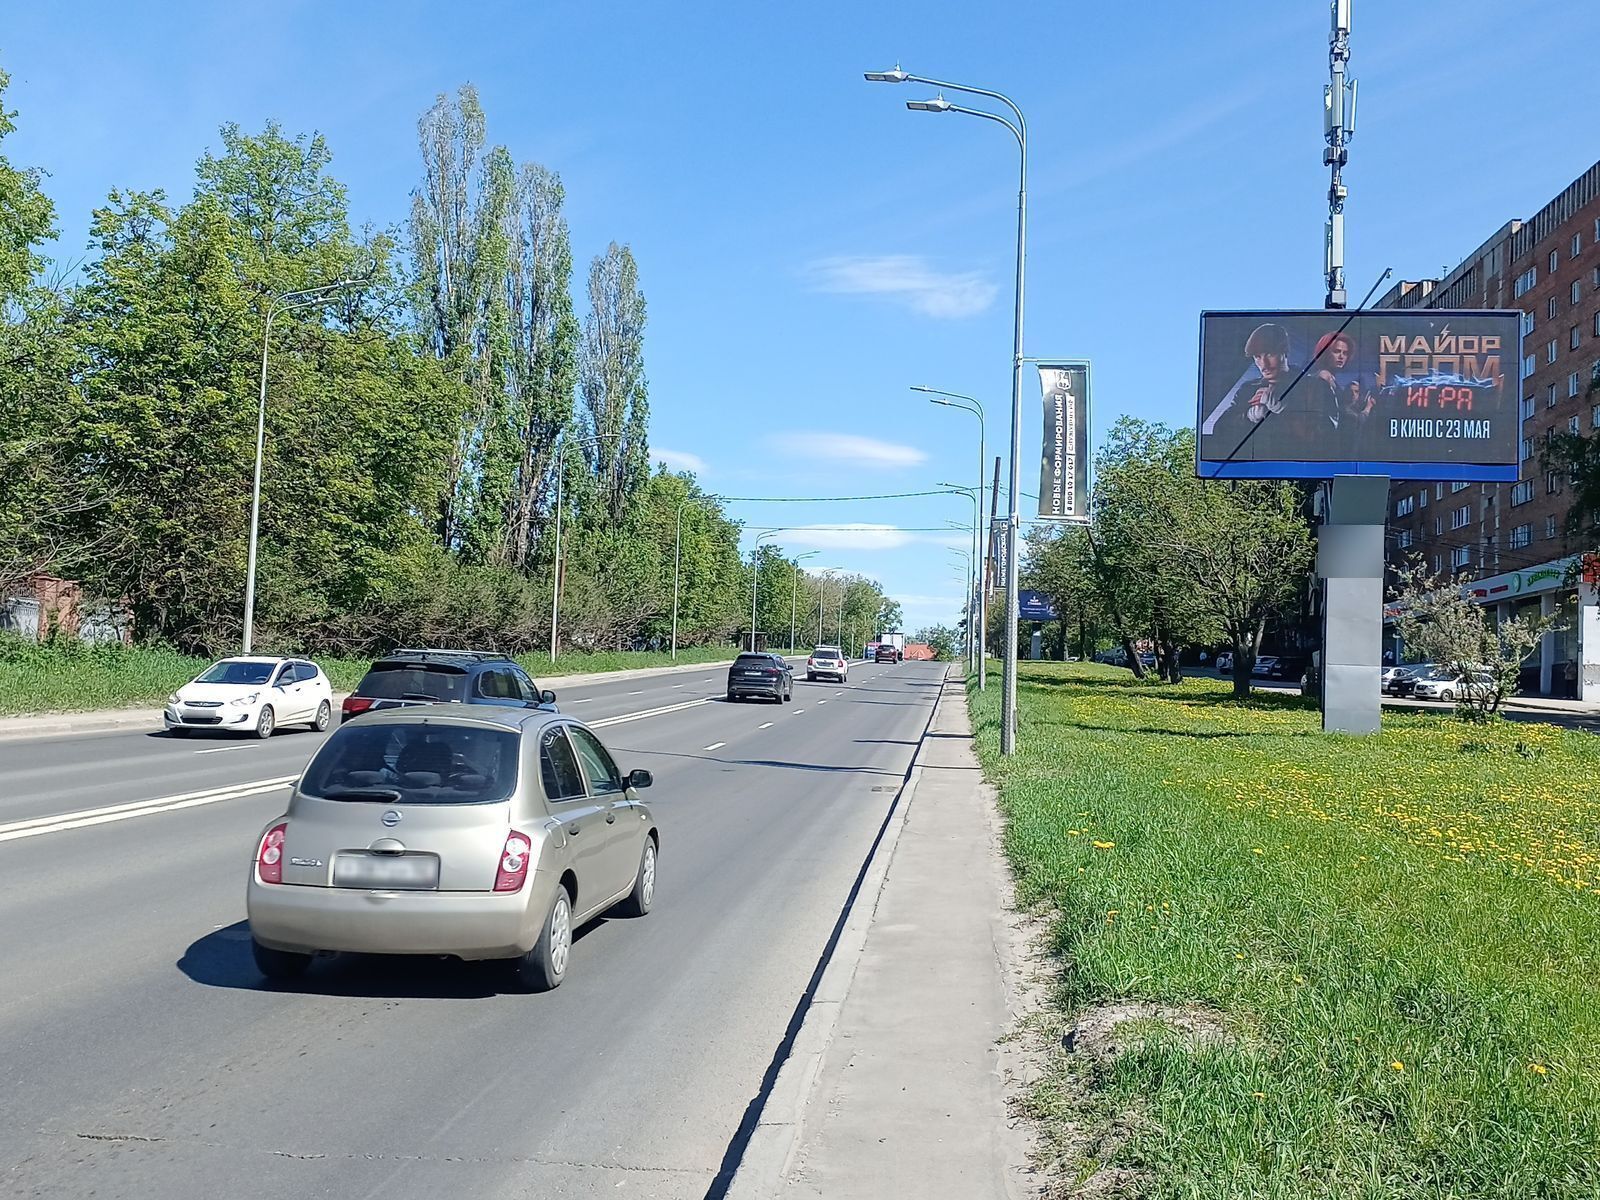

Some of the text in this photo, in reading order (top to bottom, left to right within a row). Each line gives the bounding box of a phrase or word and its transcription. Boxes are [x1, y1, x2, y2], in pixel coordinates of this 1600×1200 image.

[1380, 331, 1501, 354] МАЙОР
[1377, 354, 1503, 387] ГРОМ
[1407, 386, 1473, 411] ИГРА
[1390, 419, 1491, 439] В КИНО С 23 МАЯ
[1052, 394, 1064, 514] НОВЫЕ ФОРМИРОВАНИЯ
